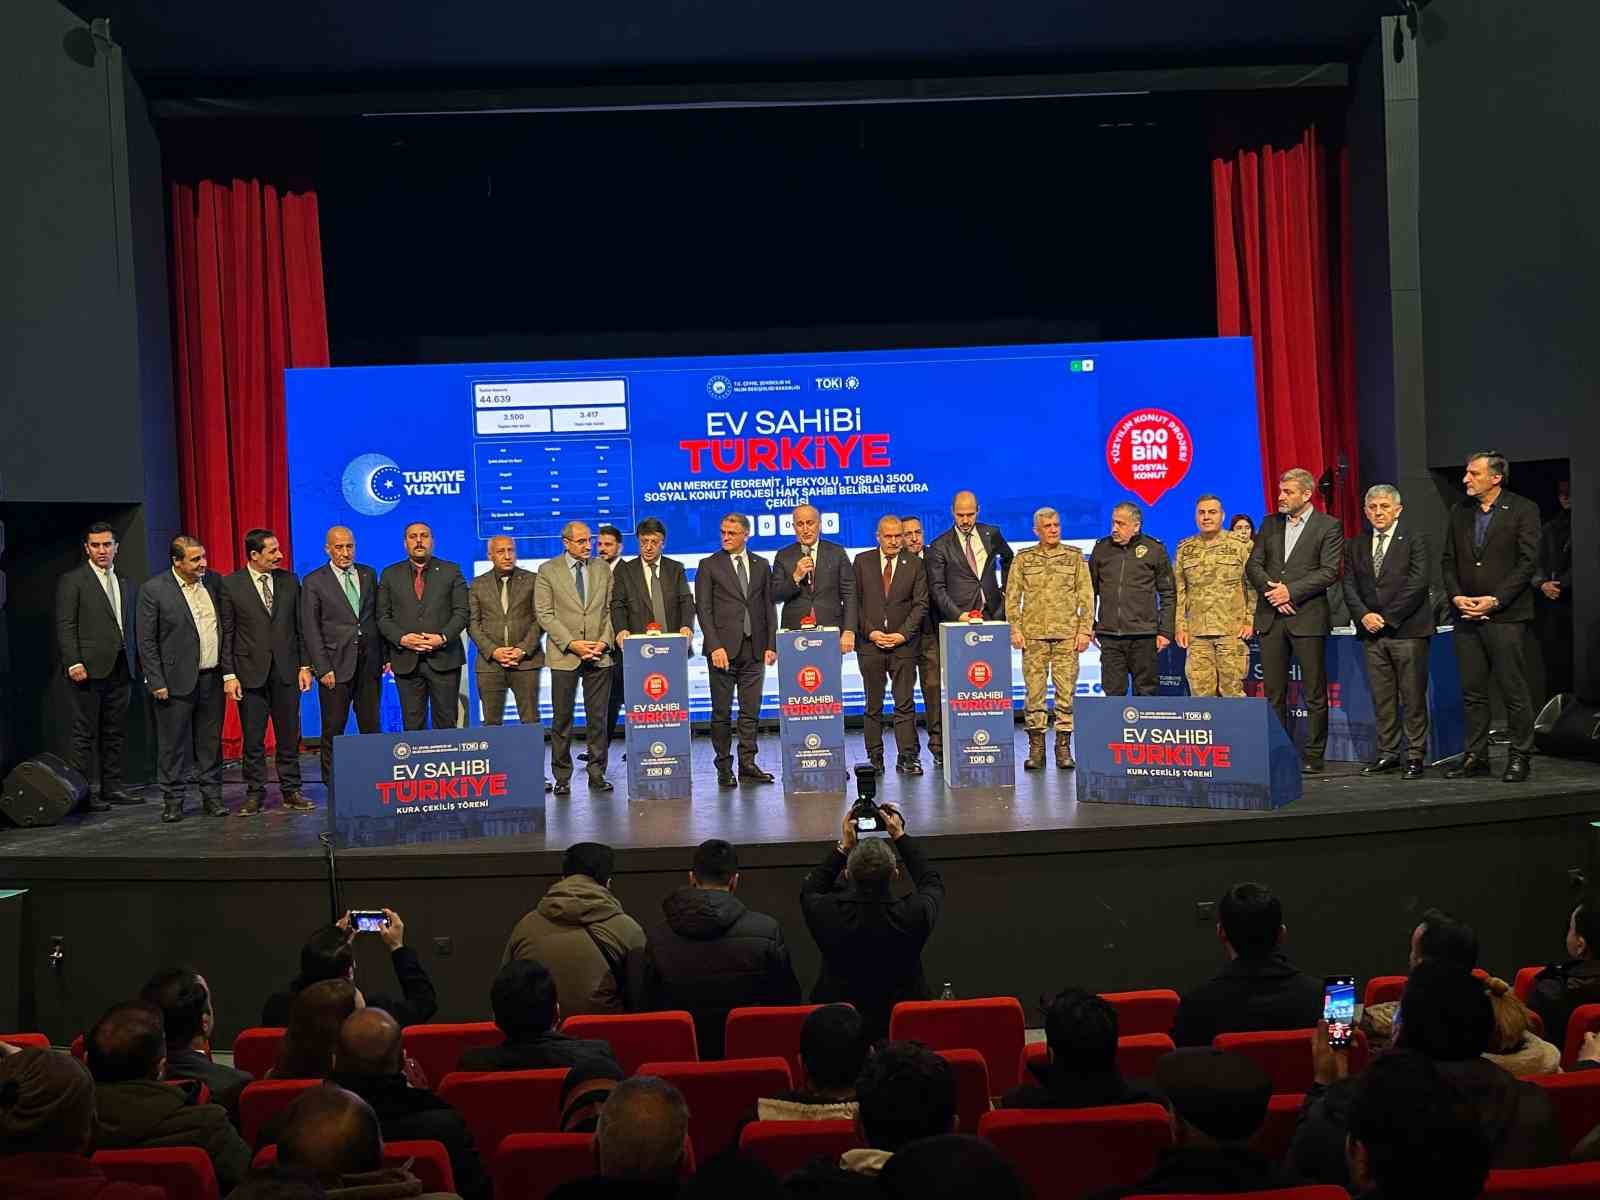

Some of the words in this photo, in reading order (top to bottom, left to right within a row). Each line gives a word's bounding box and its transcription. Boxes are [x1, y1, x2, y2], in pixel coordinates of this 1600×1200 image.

[707, 411, 748, 436] EV
[1132, 413, 1169, 424] KONUT
[1131, 428, 1168, 445] 500
[1131, 463, 1168, 472] SOSYAL
[1133, 471, 1167, 480] KONUT
[658, 481, 682, 491] VAN
[684, 479, 728, 490] MERKEZ
[886, 473, 914, 484] 3500
[644, 491, 688, 502] SOSYAL
[689, 490, 728, 500] KONUT
[776, 486, 799, 497] HAK
[898, 483, 929, 494] KURA
[1123, 728, 1147, 744] EV
[393, 764, 420, 781] EV
[1127, 768, 1149, 776] KURA
[396, 806, 420, 815] KURA
